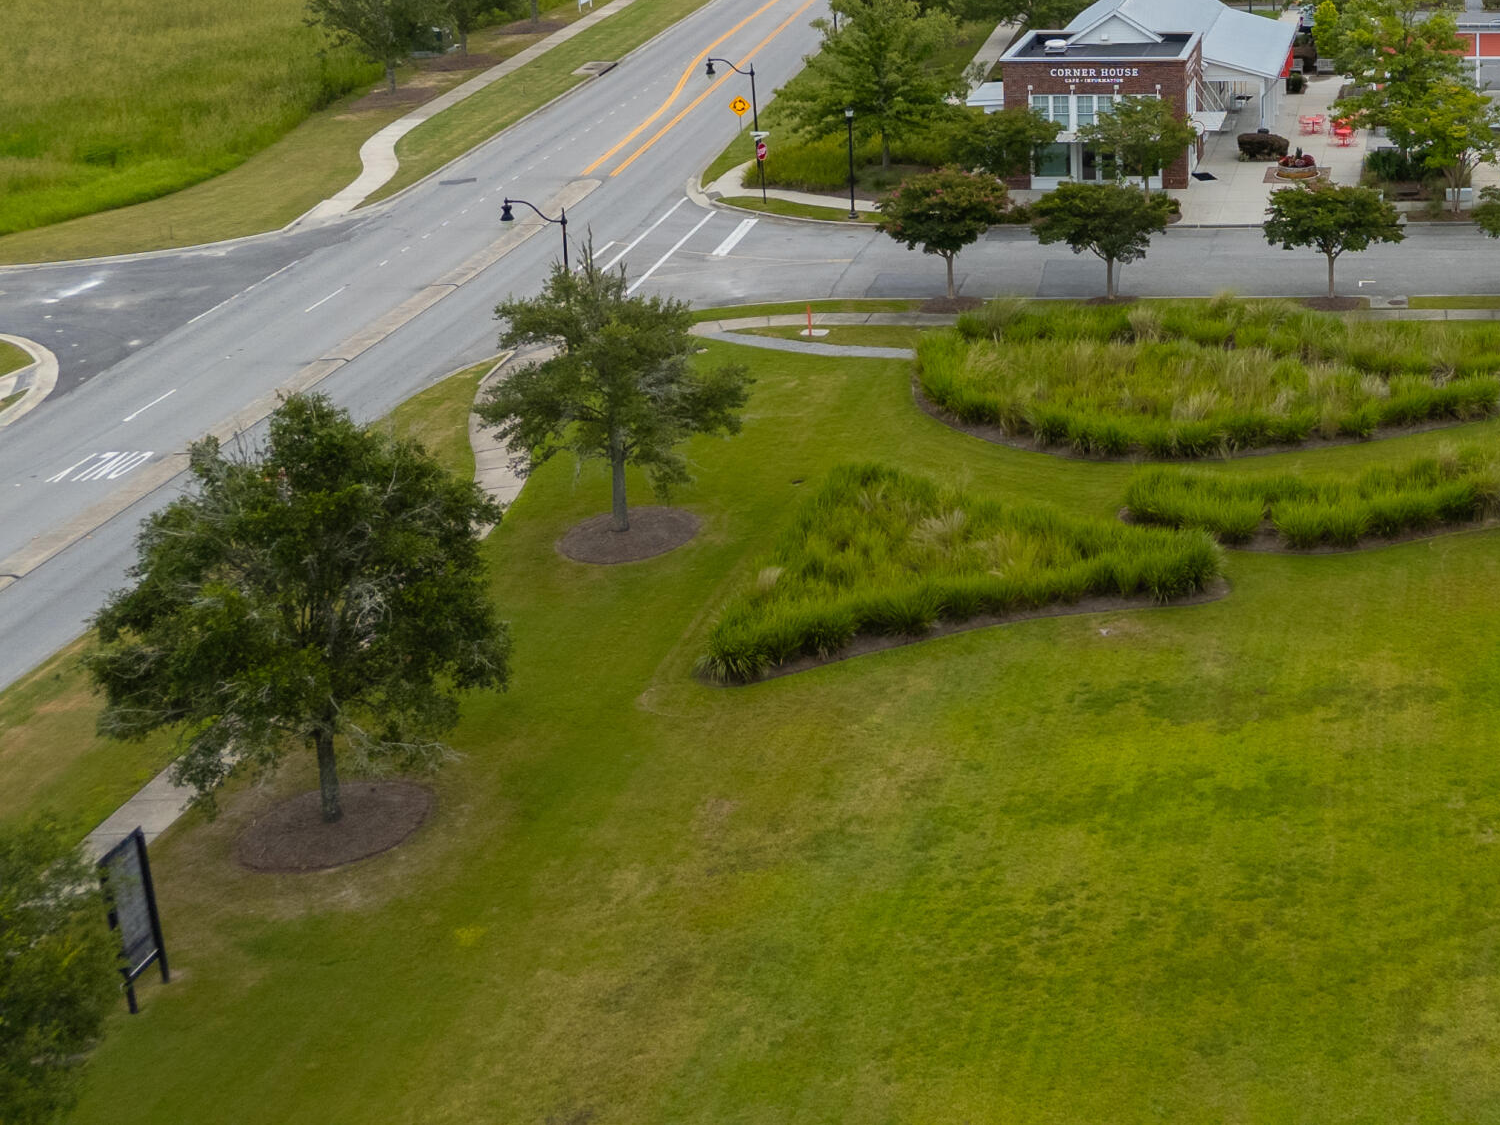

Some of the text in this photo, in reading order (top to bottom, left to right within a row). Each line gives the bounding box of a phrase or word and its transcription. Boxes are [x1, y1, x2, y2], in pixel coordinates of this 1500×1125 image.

[1050, 68, 1139, 77] CORNER HOUSE
[44, 450, 155, 483] ONLY
